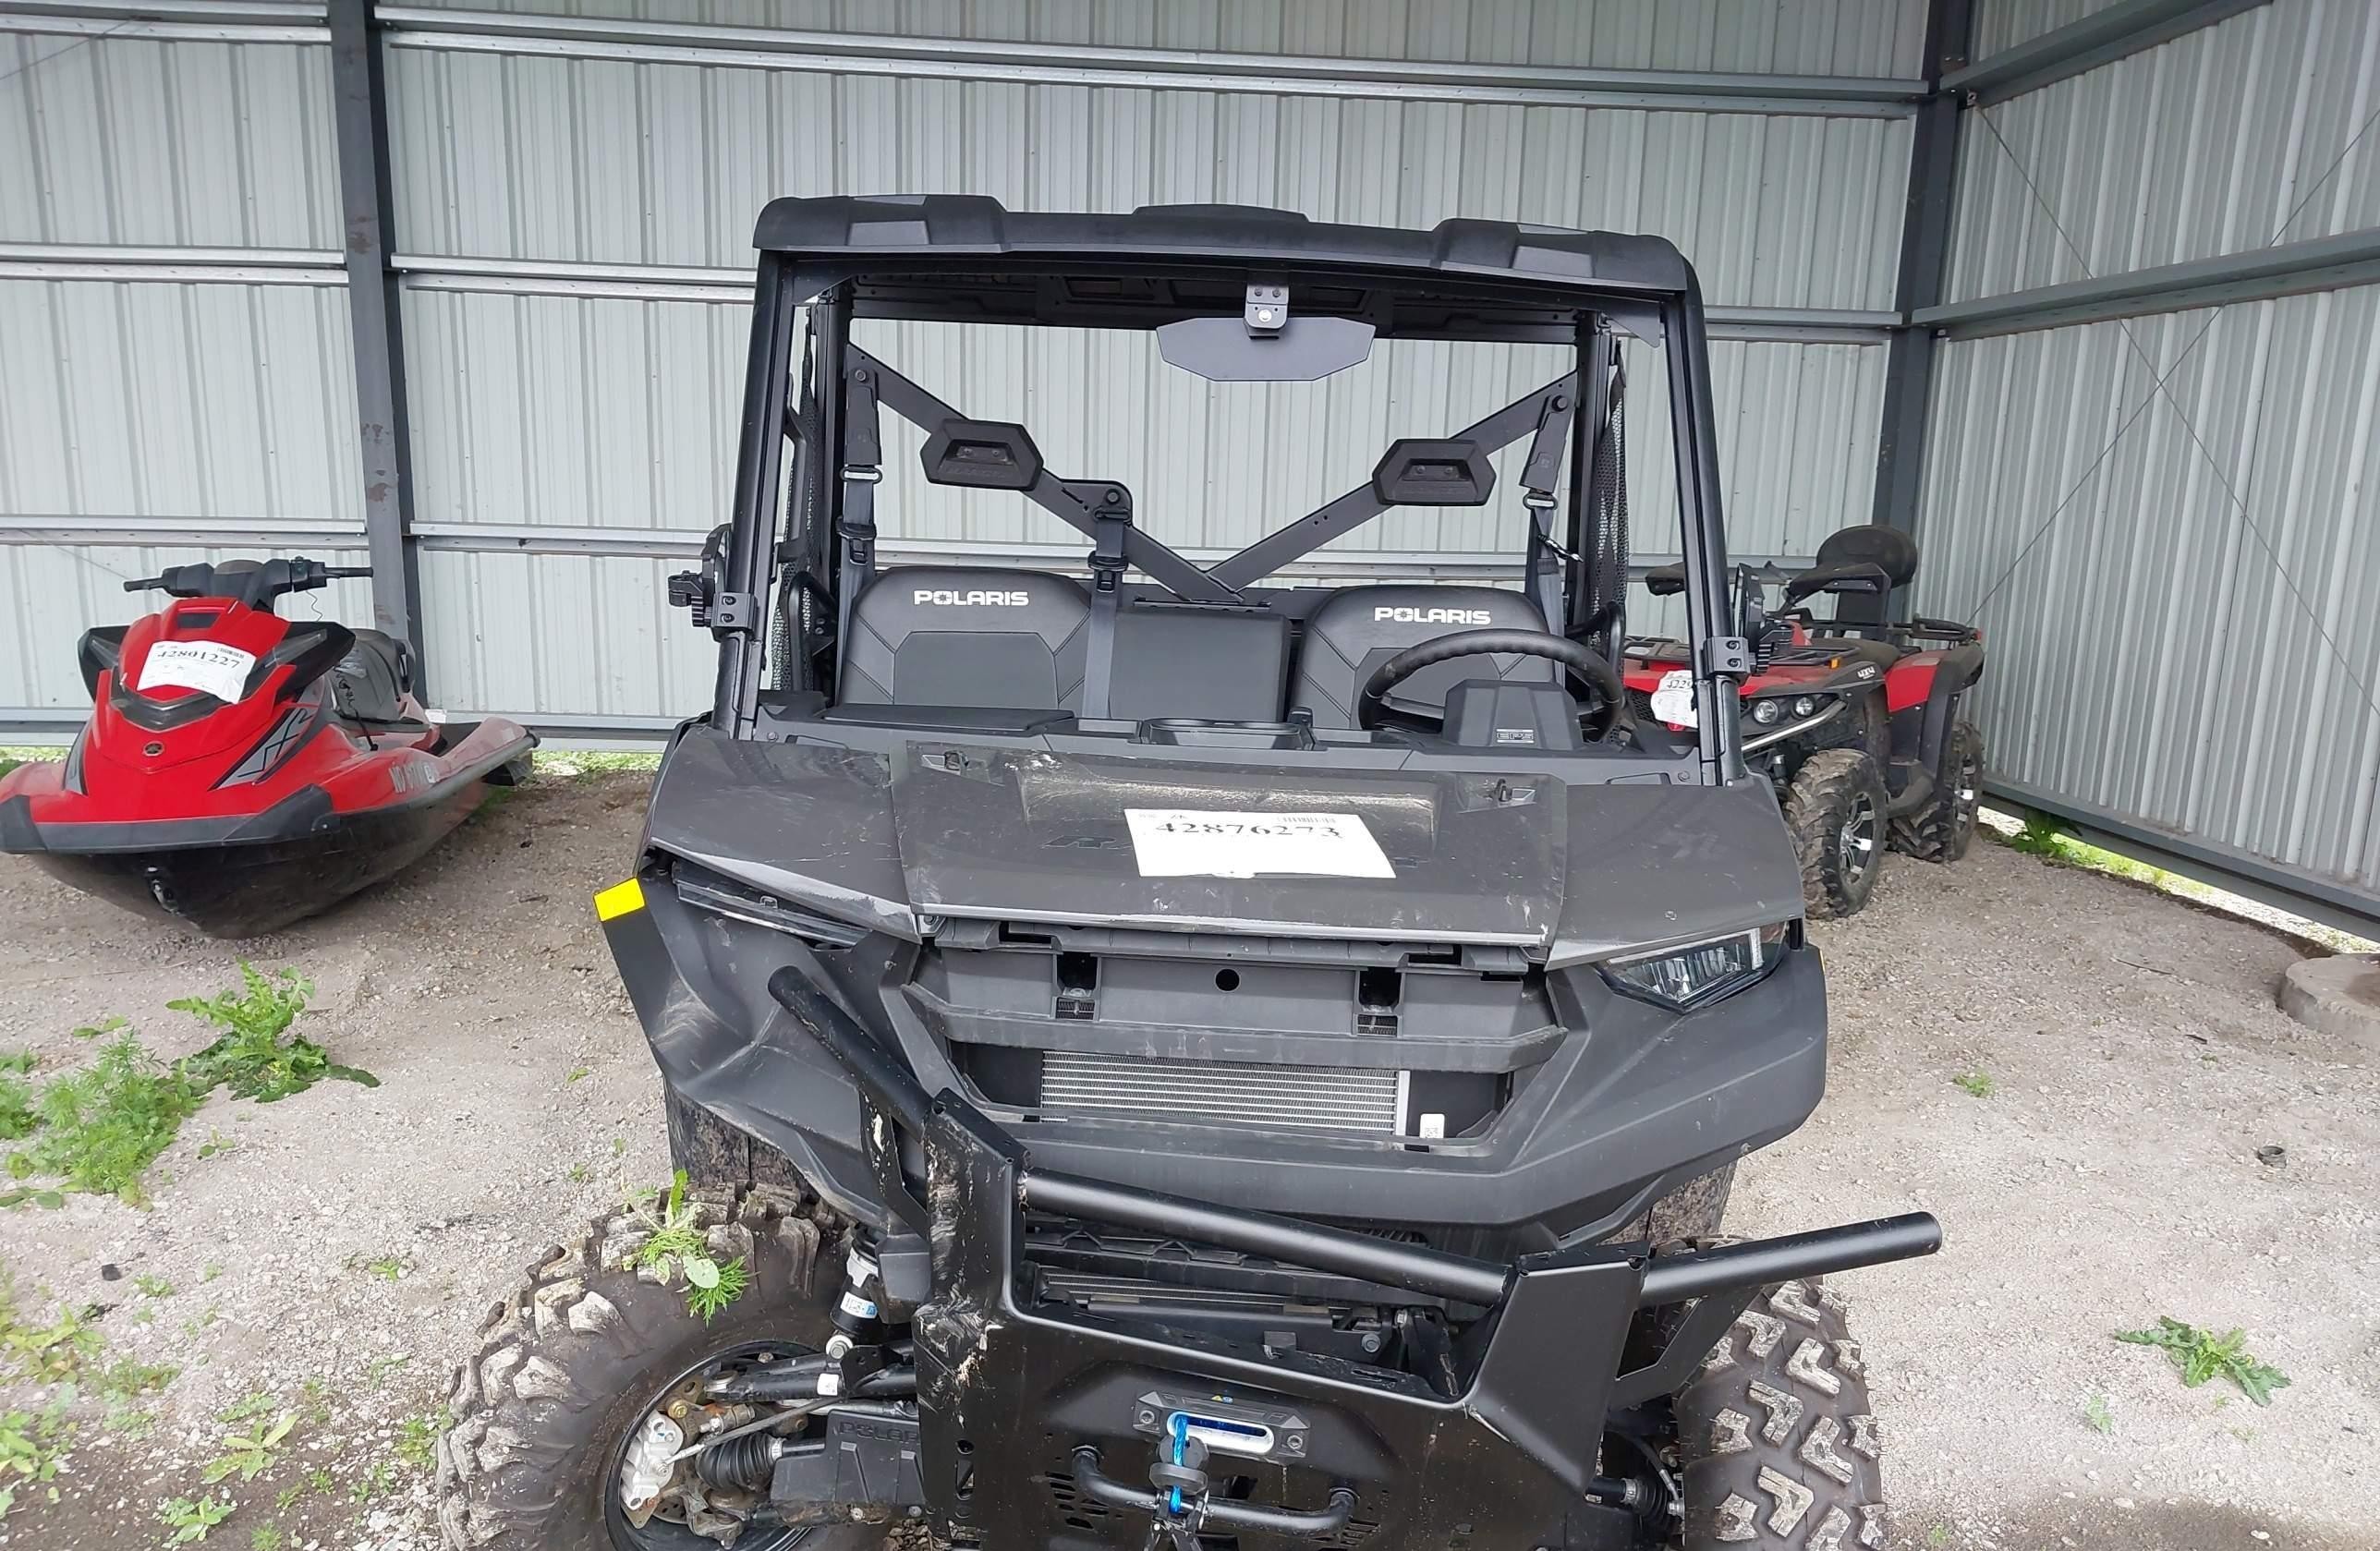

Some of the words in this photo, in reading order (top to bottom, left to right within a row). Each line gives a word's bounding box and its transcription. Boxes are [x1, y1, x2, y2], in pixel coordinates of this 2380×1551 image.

[914, 590, 1029, 606] POLARIS
[1374, 606, 1491, 625] POLARIS
[157, 650, 240, 669] 42801227
[1155, 821, 1343, 839] 42876273
